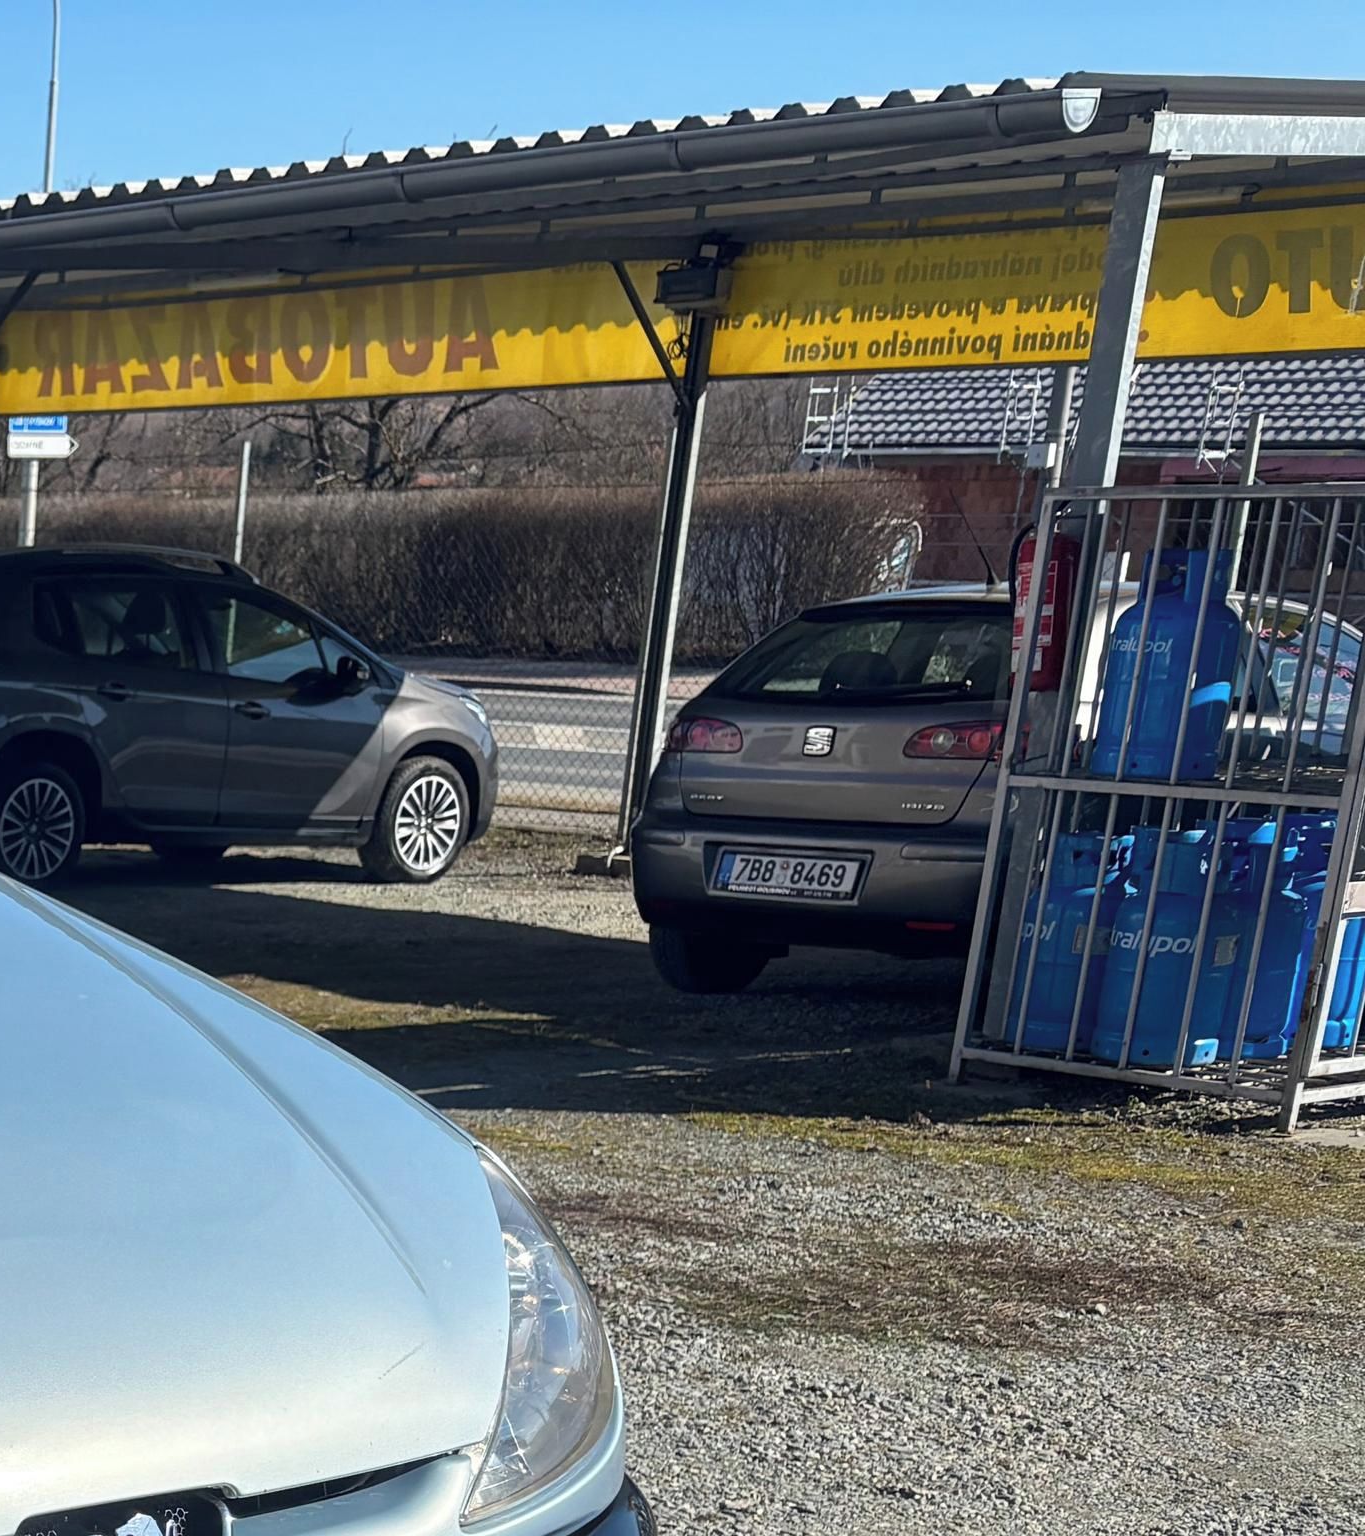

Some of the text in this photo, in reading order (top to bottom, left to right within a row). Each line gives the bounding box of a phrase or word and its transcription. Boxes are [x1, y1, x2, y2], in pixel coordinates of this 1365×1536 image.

[735, 858, 777, 883] 7B8
[790, 861, 847, 889] 8469
[1111, 921, 1199, 958] ralupol
